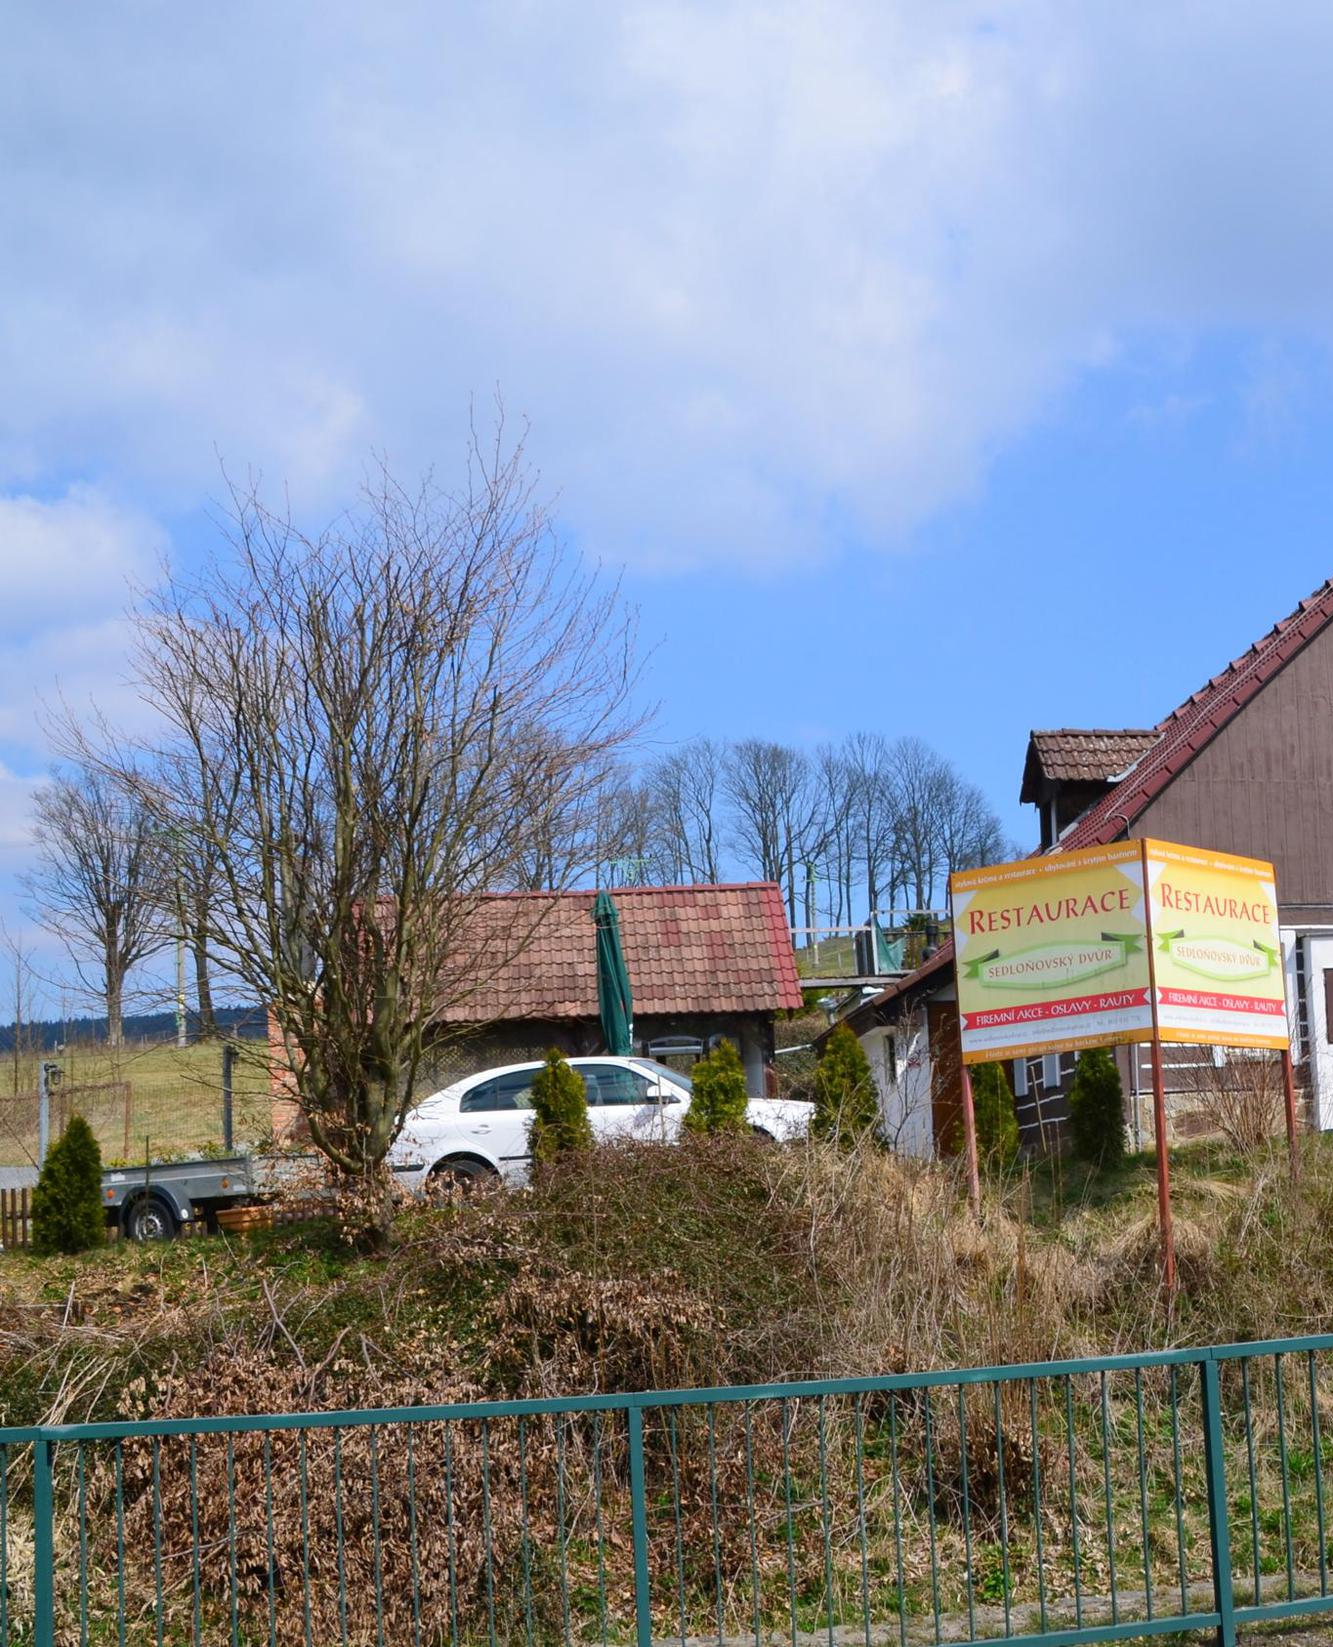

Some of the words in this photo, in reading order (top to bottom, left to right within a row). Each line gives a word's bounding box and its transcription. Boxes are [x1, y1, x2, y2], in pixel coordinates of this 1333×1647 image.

[1004, 868, 1036, 880] restaurace
[988, 955, 1074, 977] SEDLOŇOVSKÝ
[1079, 947, 1112, 964] DVŮR
[976, 1010, 1015, 1026] FIREMNÍ
[1016, 1007, 1043, 1020] AKCE
[1051, 1001, 1092, 1015] OSLAVY
[1100, 994, 1136, 1009] RAUTY
[1168, 992, 1197, 1004] FIREMNÍ
[1198, 996, 1217, 1006] AKCE
[1223, 998, 1250, 1009] OSLAVY
[1254, 1001, 1277, 1012] RAUTY
